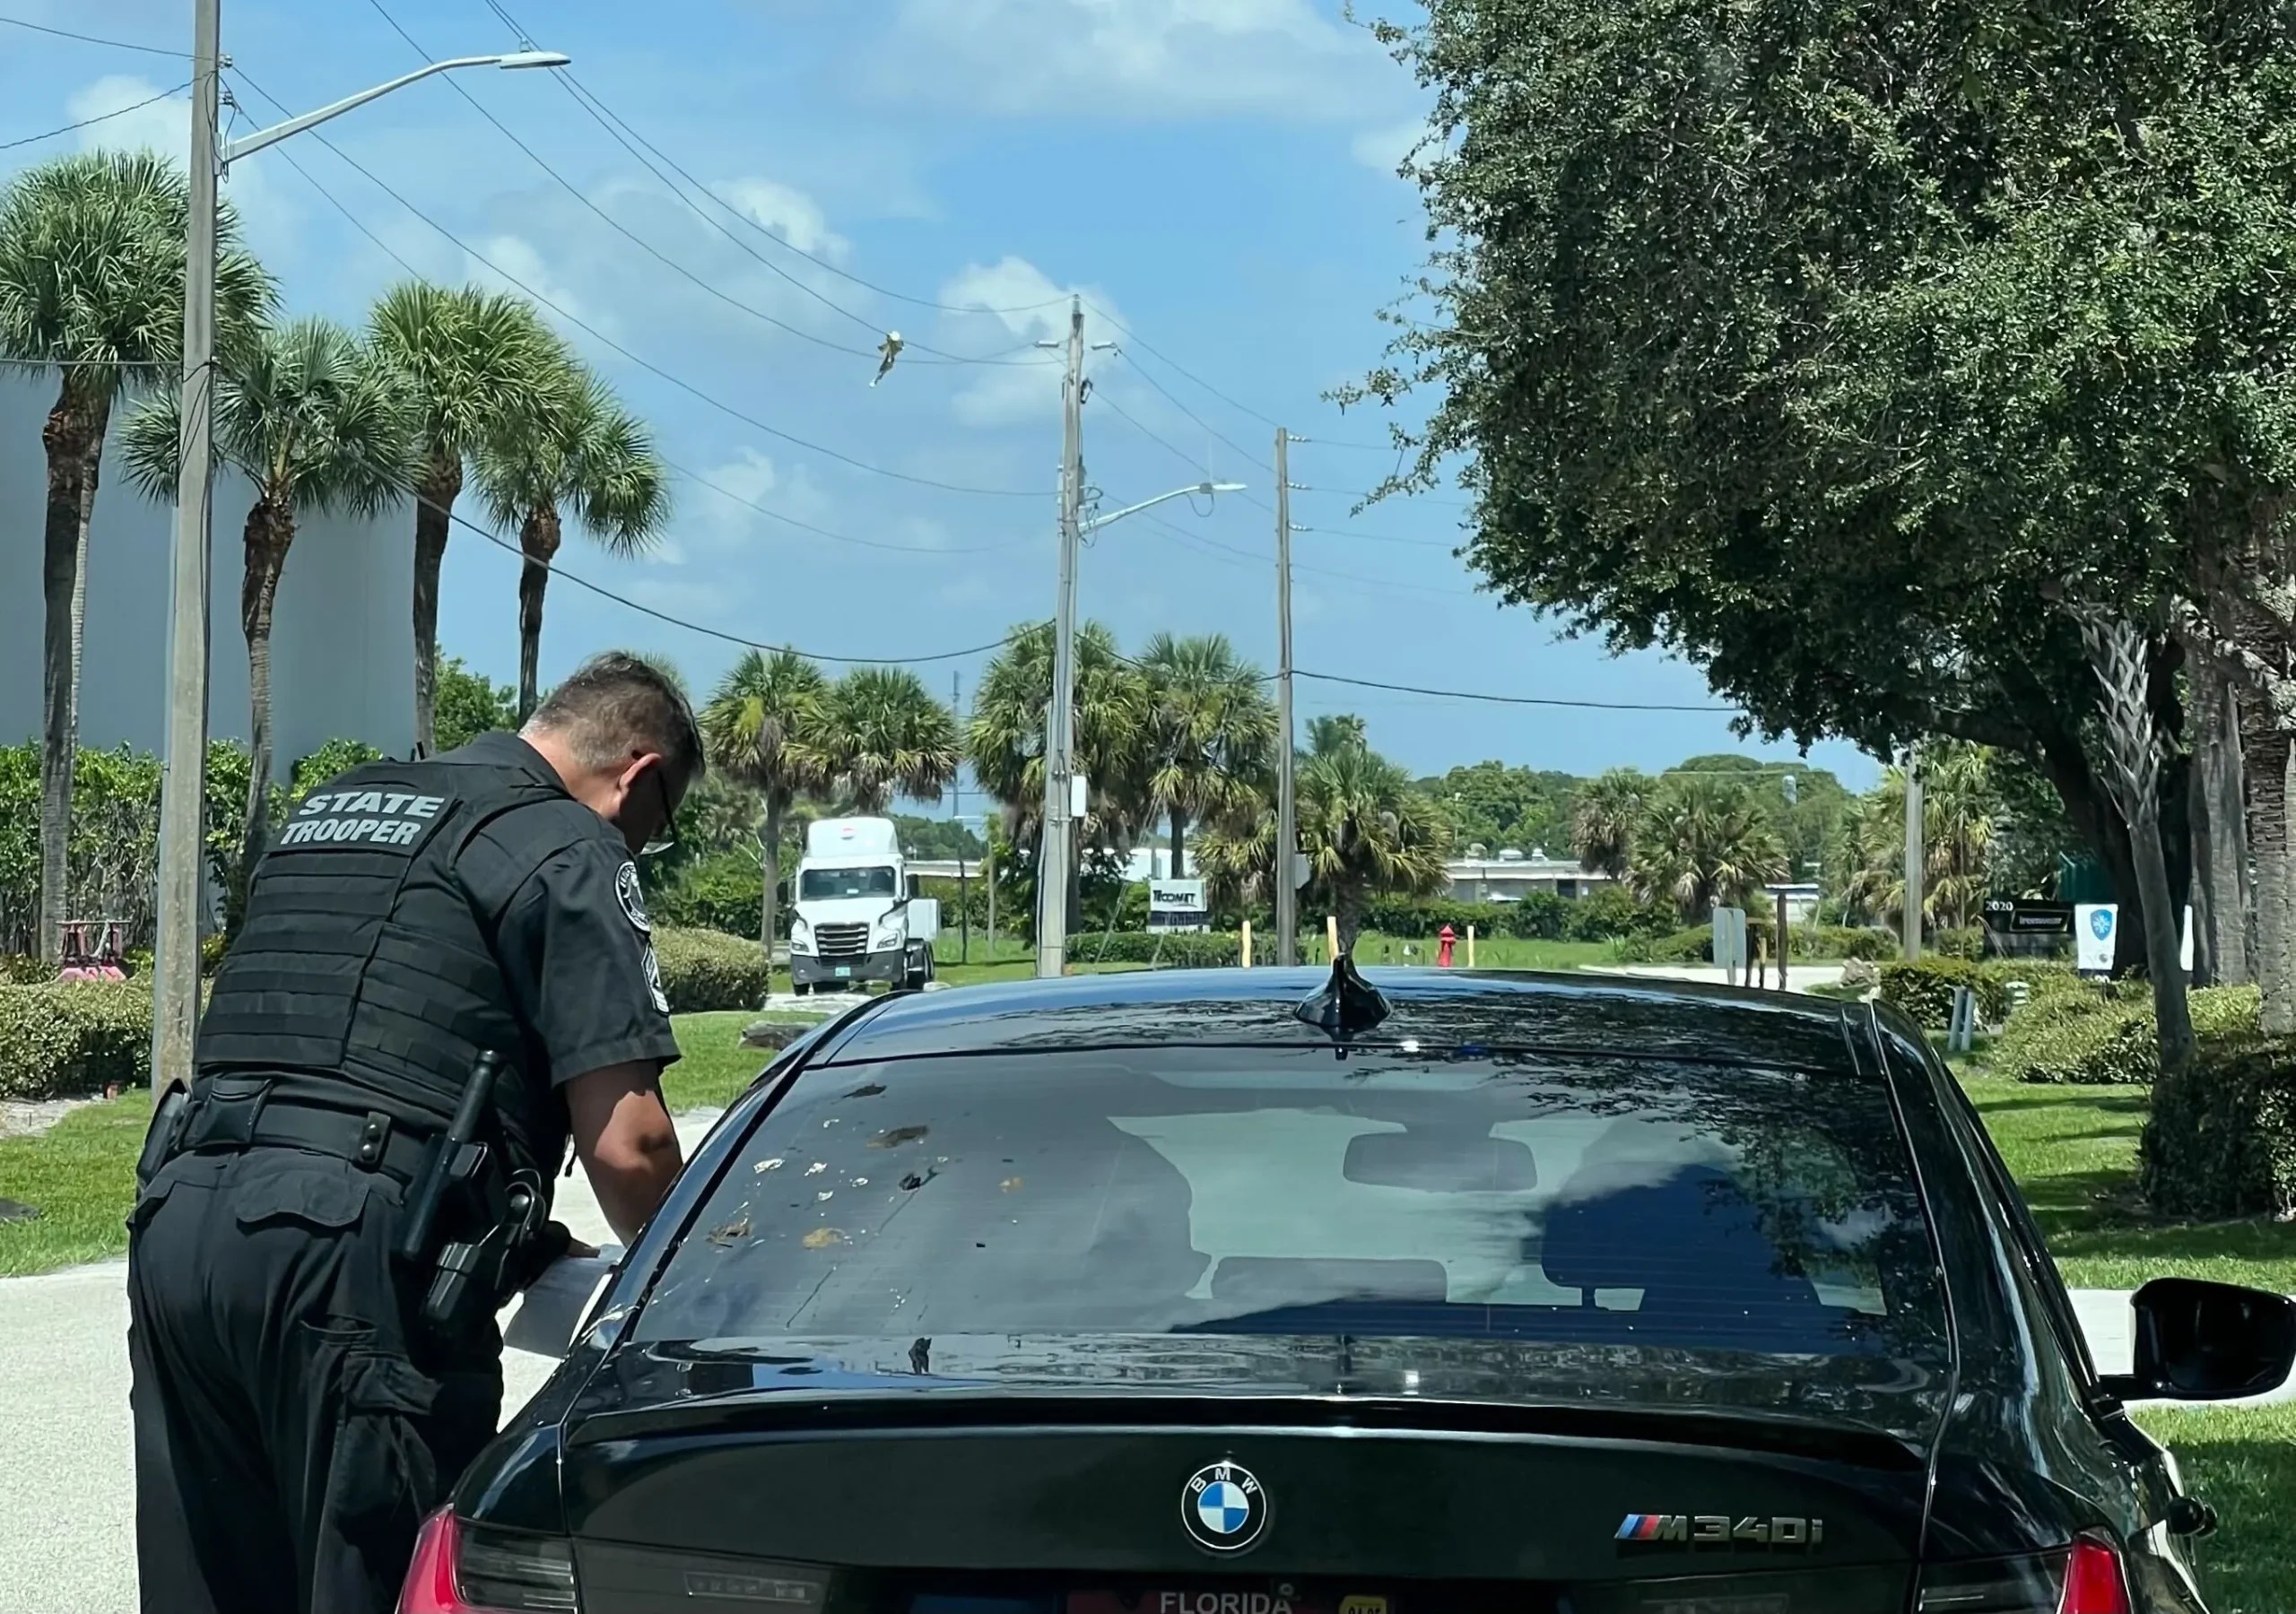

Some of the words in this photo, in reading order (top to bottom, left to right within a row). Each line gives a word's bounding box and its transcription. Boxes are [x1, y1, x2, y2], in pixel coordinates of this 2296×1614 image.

[299, 792, 445, 818] STATE
[280, 819, 421, 845] TROOPER
[1985, 900, 2013, 912] 2020
[1190, 1467, 1258, 1495] BMW
[1652, 1514, 1822, 1543] M340i
[1160, 1592, 1292, 1614] FLORIDA
